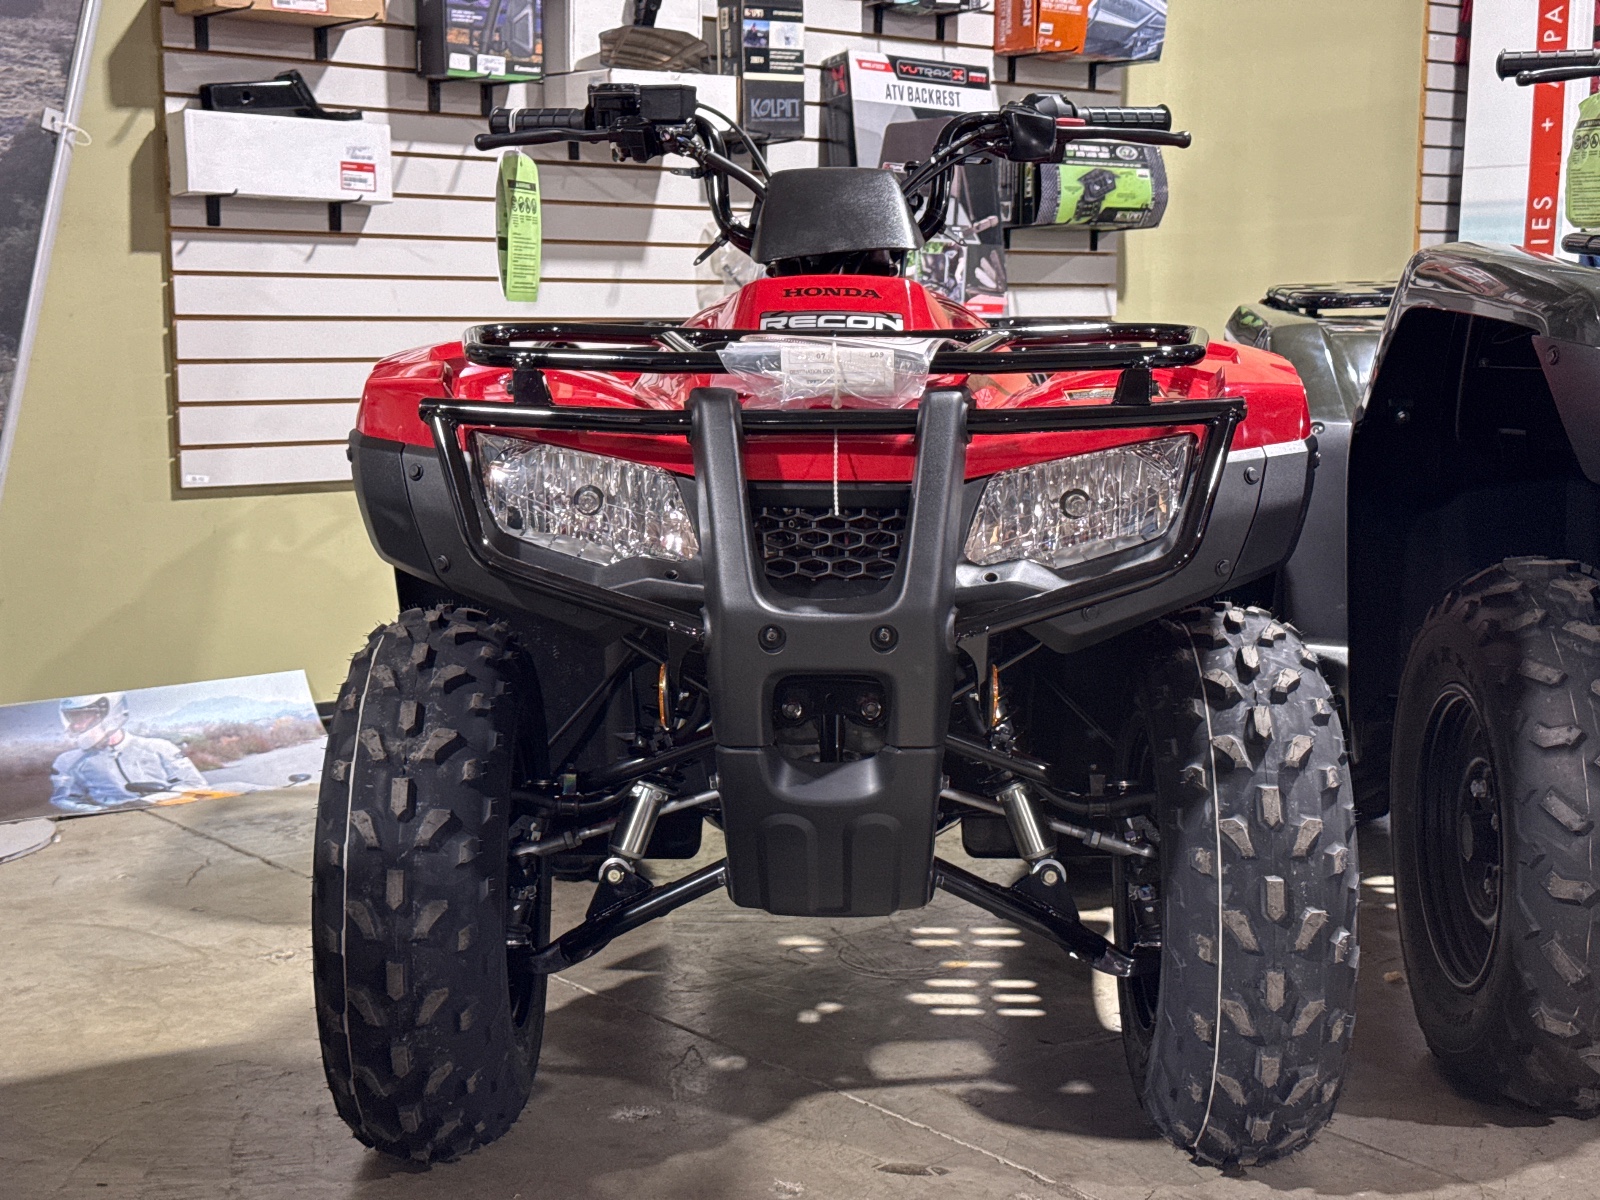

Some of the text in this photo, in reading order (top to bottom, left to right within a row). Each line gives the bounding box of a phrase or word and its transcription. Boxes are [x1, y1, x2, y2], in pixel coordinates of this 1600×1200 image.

[885, 83, 962, 108] ATV BACKREST
[782, 287, 882, 299] HONDA
[760, 315, 904, 332] RECON
